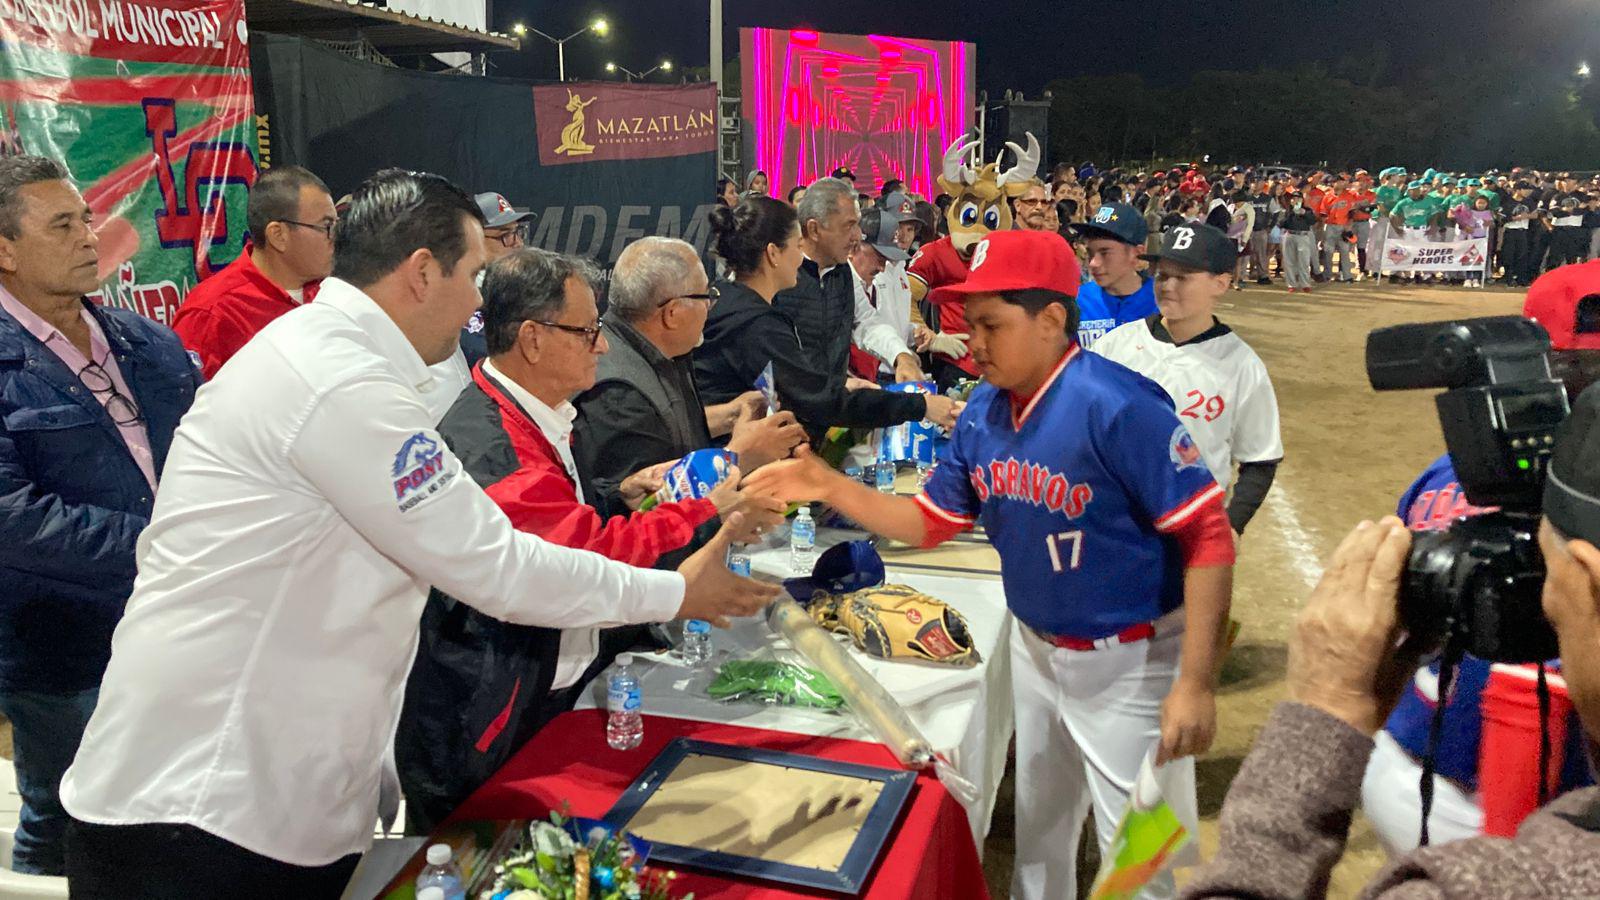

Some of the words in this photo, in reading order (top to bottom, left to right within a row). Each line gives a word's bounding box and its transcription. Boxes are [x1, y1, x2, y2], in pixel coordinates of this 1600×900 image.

[99, 0, 225, 49] MUNICIPAL
[596, 108, 714, 135] MAZATLÁN
[1172, 226, 1196, 250] B
[1417, 247, 1455, 256] SUPER
[969, 239, 990, 272] B
[1411, 255, 1455, 265] HEROES
[1180, 389, 1225, 422] 29
[393, 450, 444, 501] PONY
[988, 456, 1093, 520] BRAVOS
[1046, 530, 1083, 572] 17
